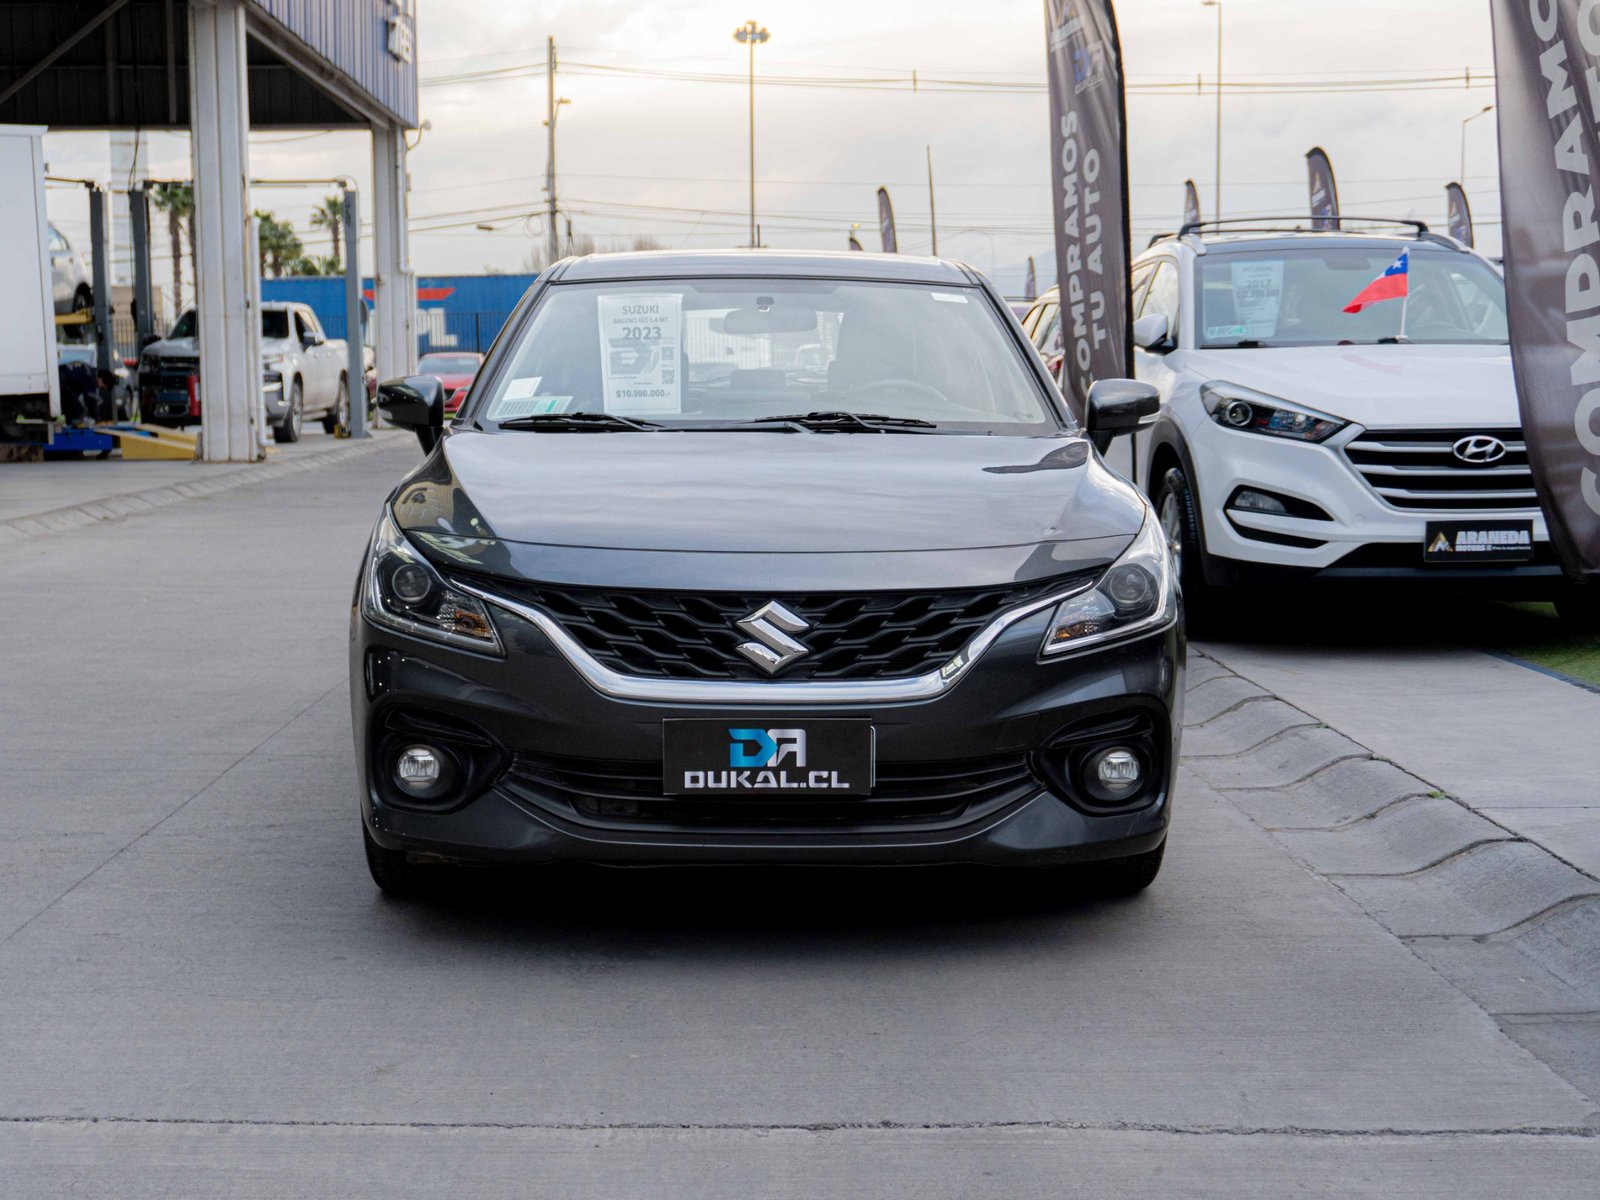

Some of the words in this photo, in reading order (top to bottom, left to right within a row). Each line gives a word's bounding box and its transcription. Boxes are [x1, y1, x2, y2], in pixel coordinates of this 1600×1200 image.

[1083, 148, 1103, 275] AUTO
[622, 304, 659, 315] SUZUKI
[1090, 290, 1106, 350] TU
[622, 326, 661, 340] 2023
[1455, 530, 1530, 544] ARANEDA
[684, 770, 850, 788] DUKAL.CL
